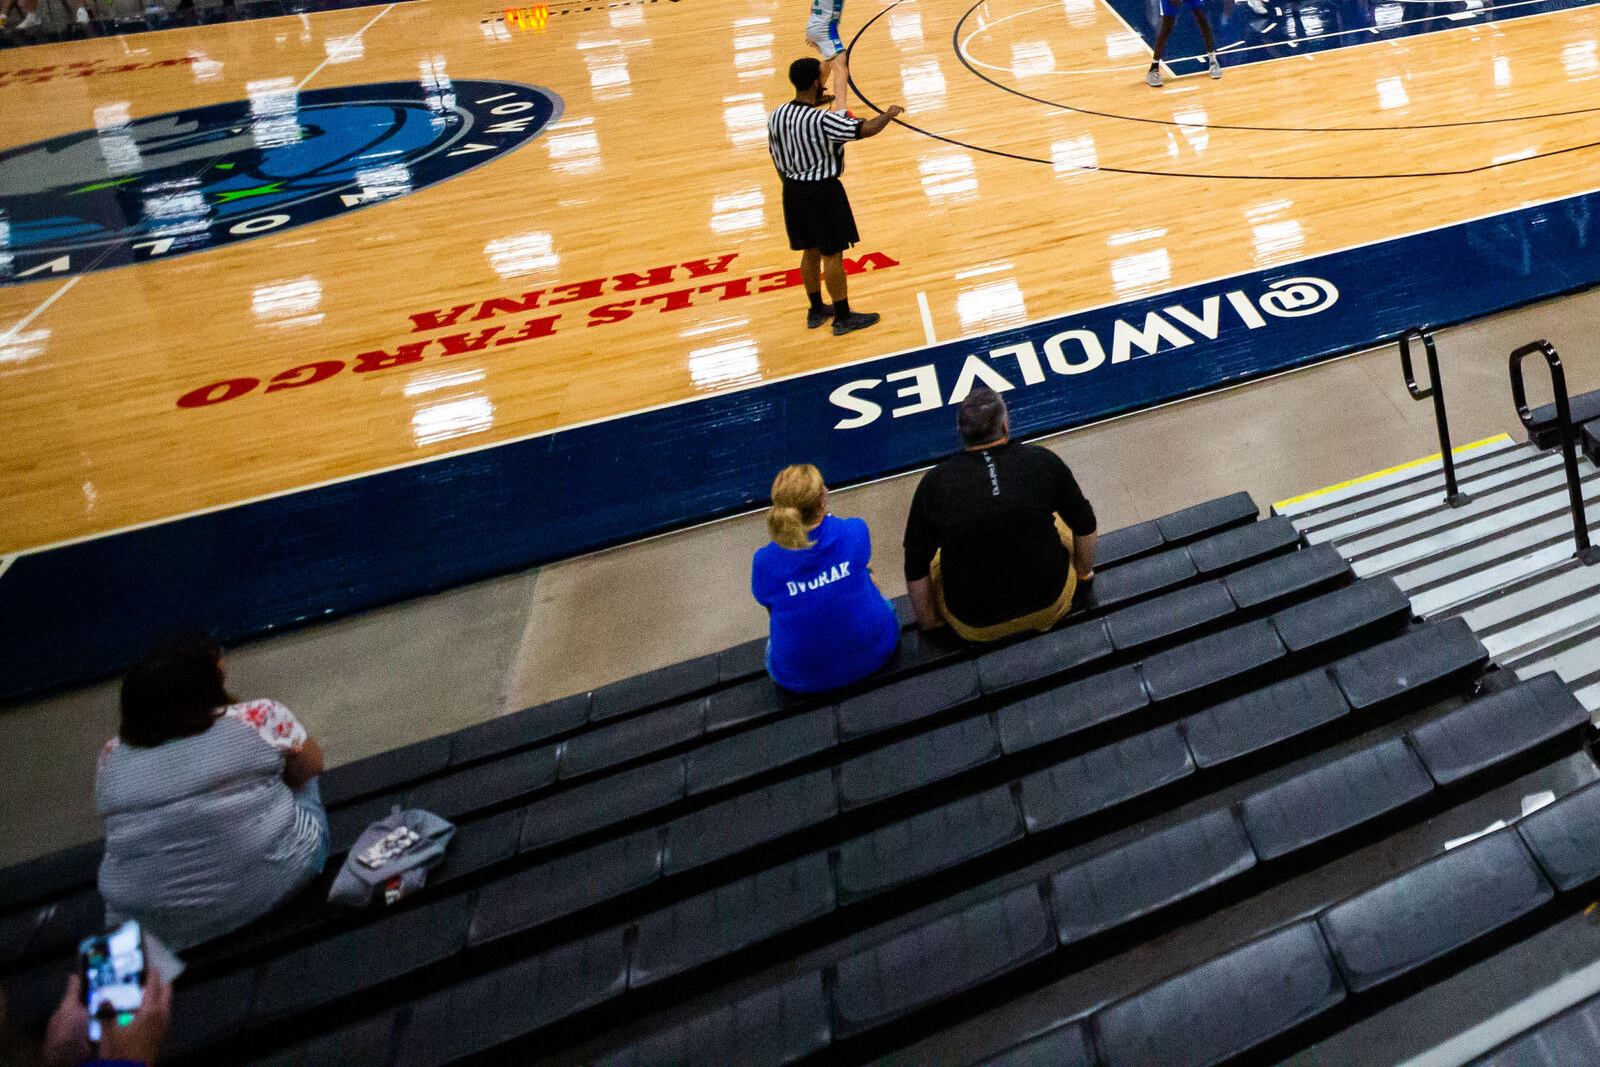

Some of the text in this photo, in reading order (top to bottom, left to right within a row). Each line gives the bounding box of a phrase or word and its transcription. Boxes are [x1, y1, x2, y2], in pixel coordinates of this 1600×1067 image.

[447, 91, 535, 158] IOWA
[176, 252, 900, 409] WELLS FARGO
[410, 253, 739, 333] ARENA
[829, 276, 1340, 430] @IAWOLVES
